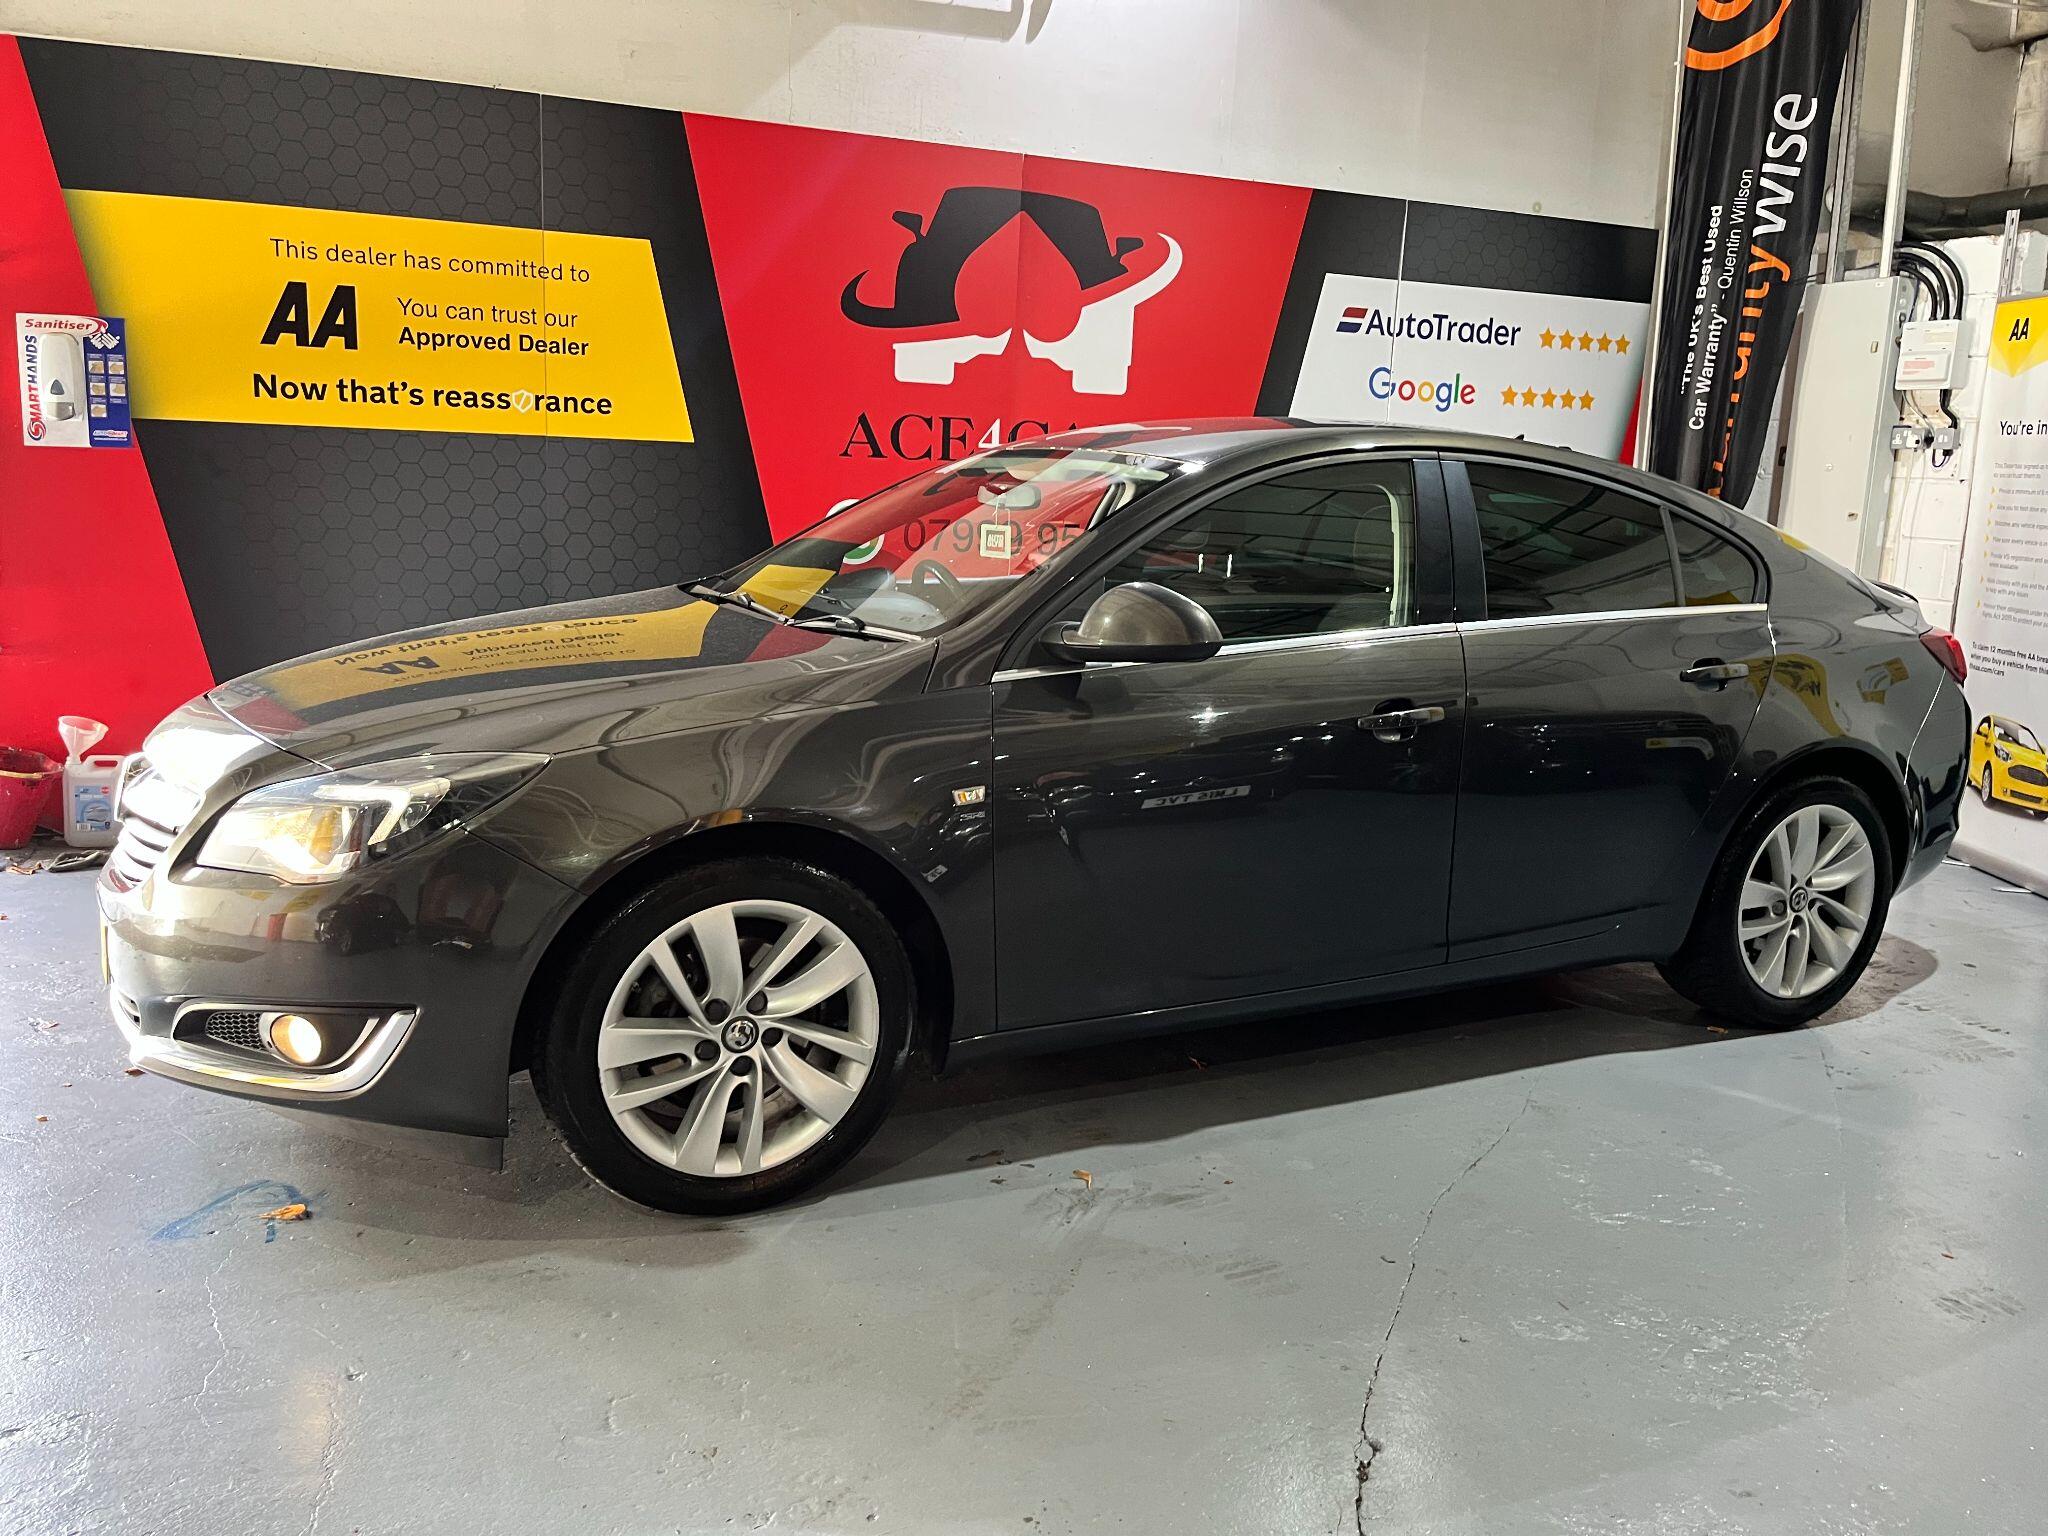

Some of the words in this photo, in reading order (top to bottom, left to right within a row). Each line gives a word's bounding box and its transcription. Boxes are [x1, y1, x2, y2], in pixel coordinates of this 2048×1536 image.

[1729, 169, 1754, 225] Willson
[1703, 205, 1723, 252] Used
[269, 237, 318, 260] This
[326, 243, 397, 267] dealer
[404, 250, 441, 270] has
[449, 258, 563, 281] committed
[570, 264, 590, 283] to
[1717, 229, 1742, 289] Quentin
[1696, 257, 1713, 299] Best
[25, 318, 92, 330] Sanitiser
[260, 281, 358, 350] AA
[396, 296, 438, 318] You
[445, 305, 484, 322] can
[491, 305, 538, 325] trust
[544, 313, 578, 328] our
[1365, 309, 1521, 347] AutoTrader
[398, 325, 511, 351] Approved
[519, 334, 590, 356] Dealer
[2008, 317, 2030, 342] AA
[253, 373, 328, 401] Now
[1369, 366, 1476, 412] Google
[1688, 398, 1708, 430] Car
[1999, 420, 2034, 436] You're
[2006, 660, 2025, 670] vehicle
[2025, 663, 2038, 673] from
[2016, 650, 2027, 659] free
[2027, 653, 2036, 661] AA
